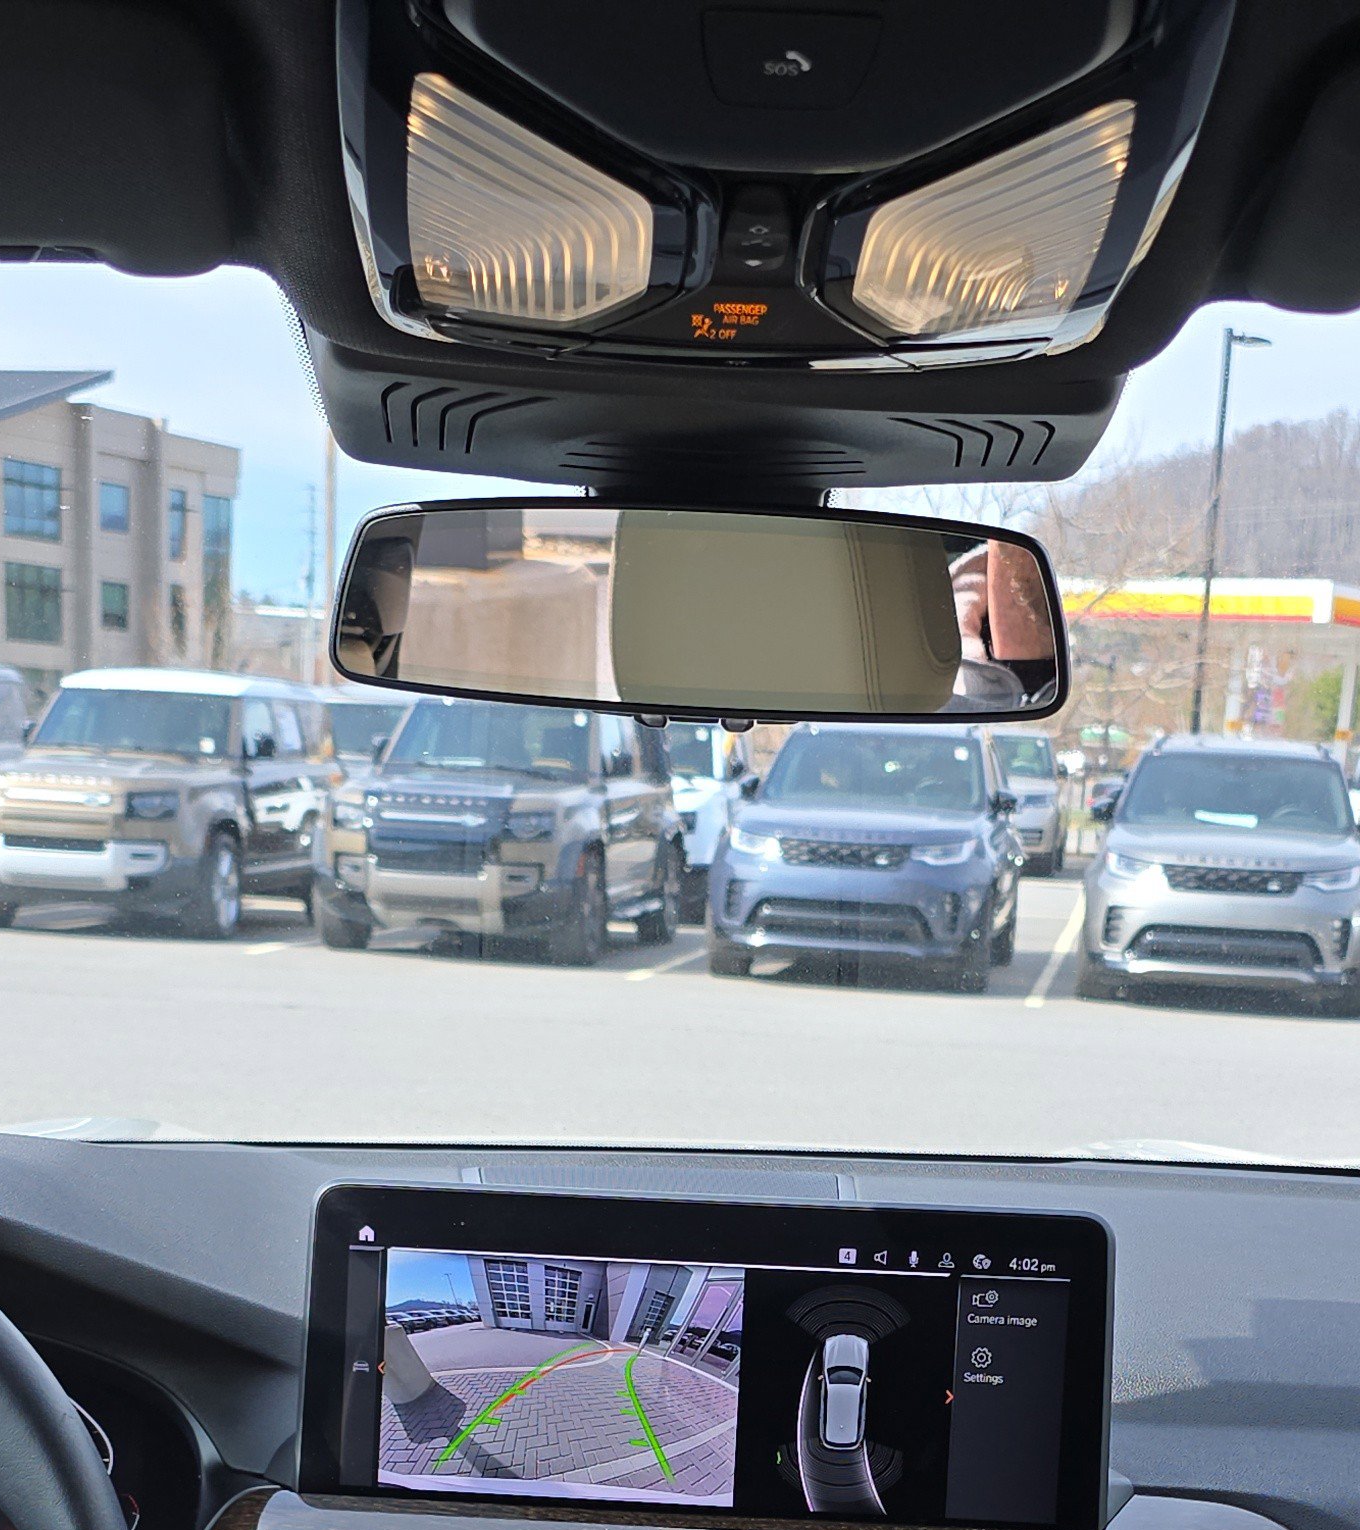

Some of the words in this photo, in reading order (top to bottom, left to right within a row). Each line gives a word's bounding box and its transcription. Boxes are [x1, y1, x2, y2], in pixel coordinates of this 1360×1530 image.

[763, 61, 799, 77] SOS
[713, 302, 768, 316] PASSENGER
[722, 315, 739, 325] AIR
[739, 315, 759, 326] BAG
[718, 328, 737, 340] OFF
[1008, 1257, 1040, 1272] 4:02
[1040, 1263, 1057, 1274] pm
[967, 1313, 1005, 1326] Camera
[1006, 1314, 1038, 1328] image
[962, 1371, 1005, 1387] Settings
